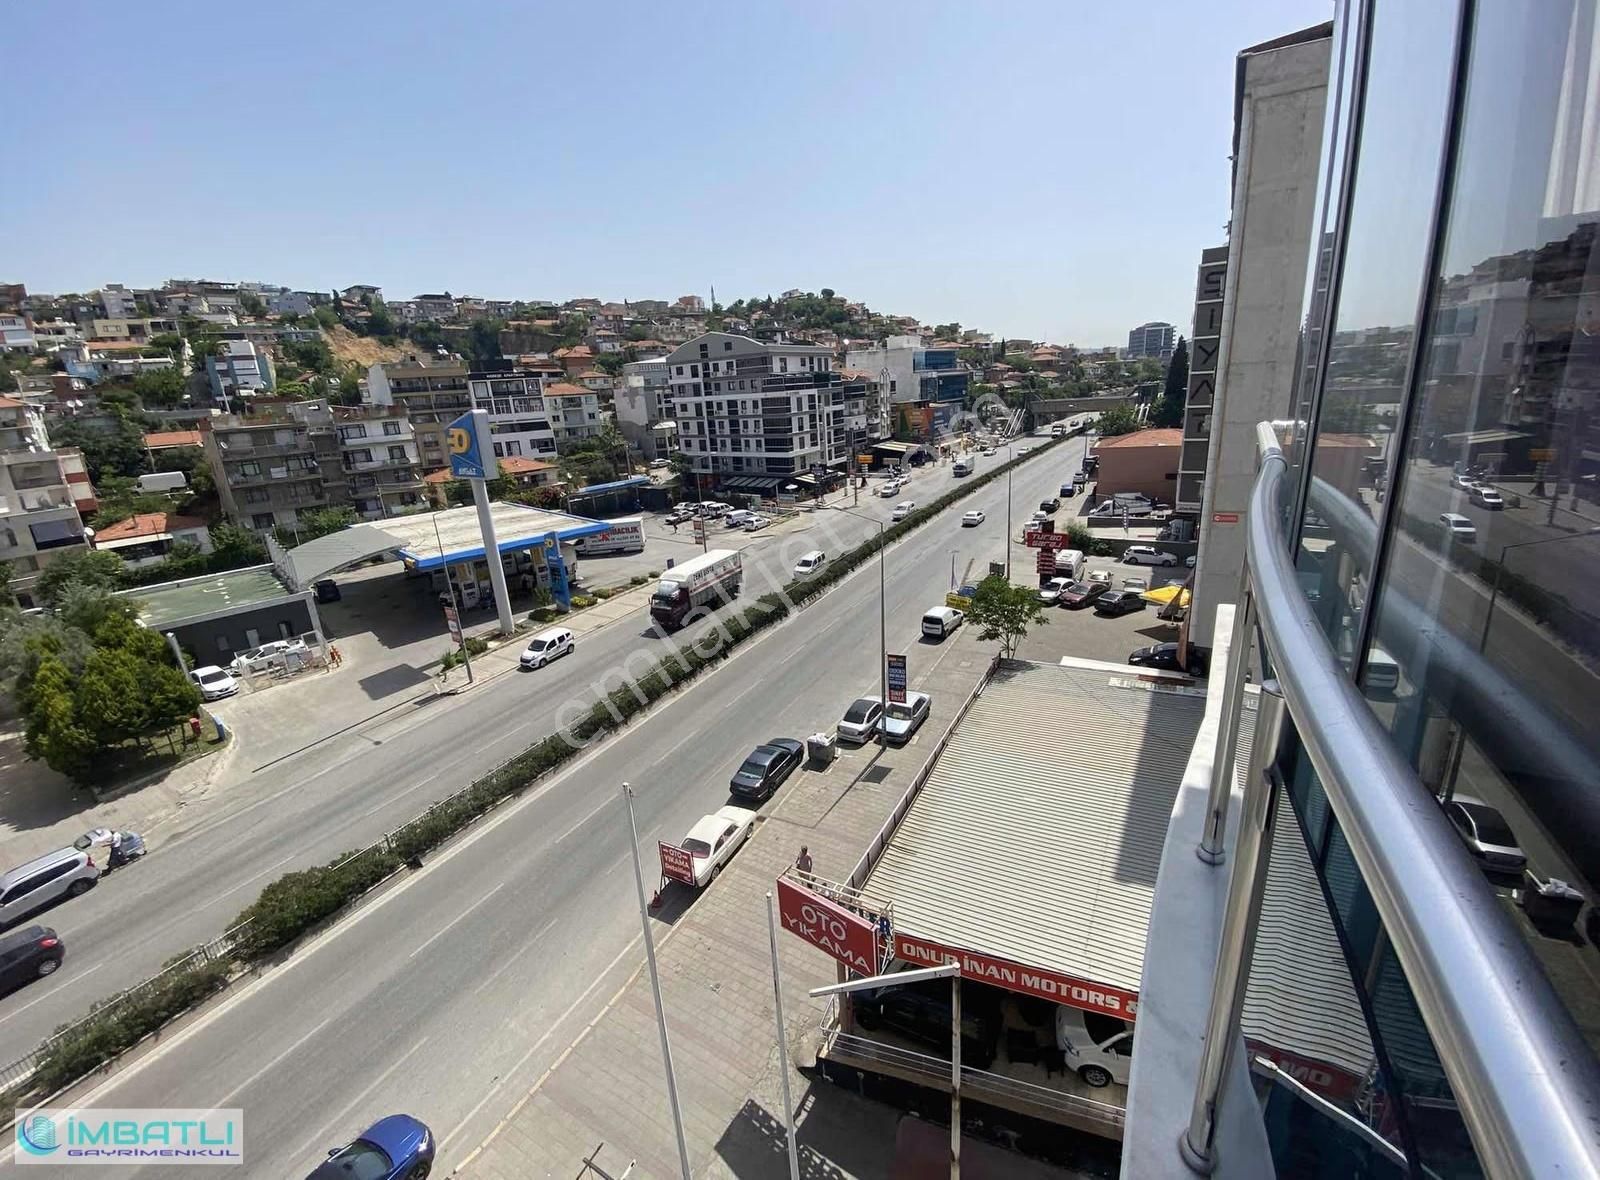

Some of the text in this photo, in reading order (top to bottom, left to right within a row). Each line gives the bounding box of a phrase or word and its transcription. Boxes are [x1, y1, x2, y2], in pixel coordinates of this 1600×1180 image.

[668, 848, 682, 858] OTO
[783, 911, 872, 974] YIKAMA
[801, 905, 846, 941] OTO
[964, 955, 1016, 982] İNAN
[1021, 972, 1120, 1010] MOTORS
